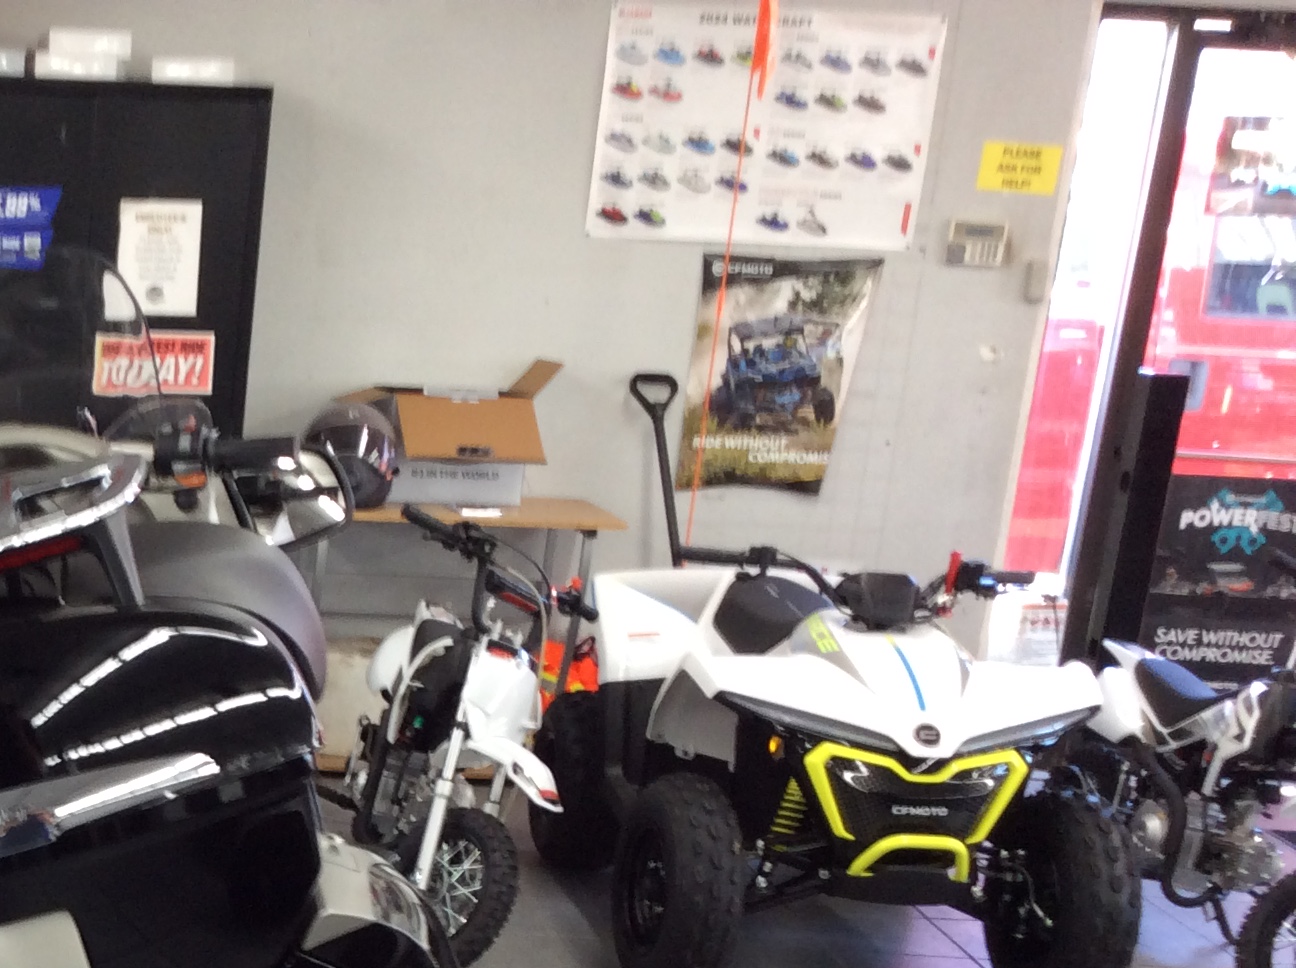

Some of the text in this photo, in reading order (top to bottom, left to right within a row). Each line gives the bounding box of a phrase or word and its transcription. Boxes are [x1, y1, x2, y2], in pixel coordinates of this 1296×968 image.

[1002, 146, 1042, 160] PLEASE
[100, 353, 204, 387] TODAY!
[724, 434, 788, 451] WITHOUT
[1155, 627, 1285, 648] SAVE WITHOUT
[891, 805, 949, 816] CFMOTO
